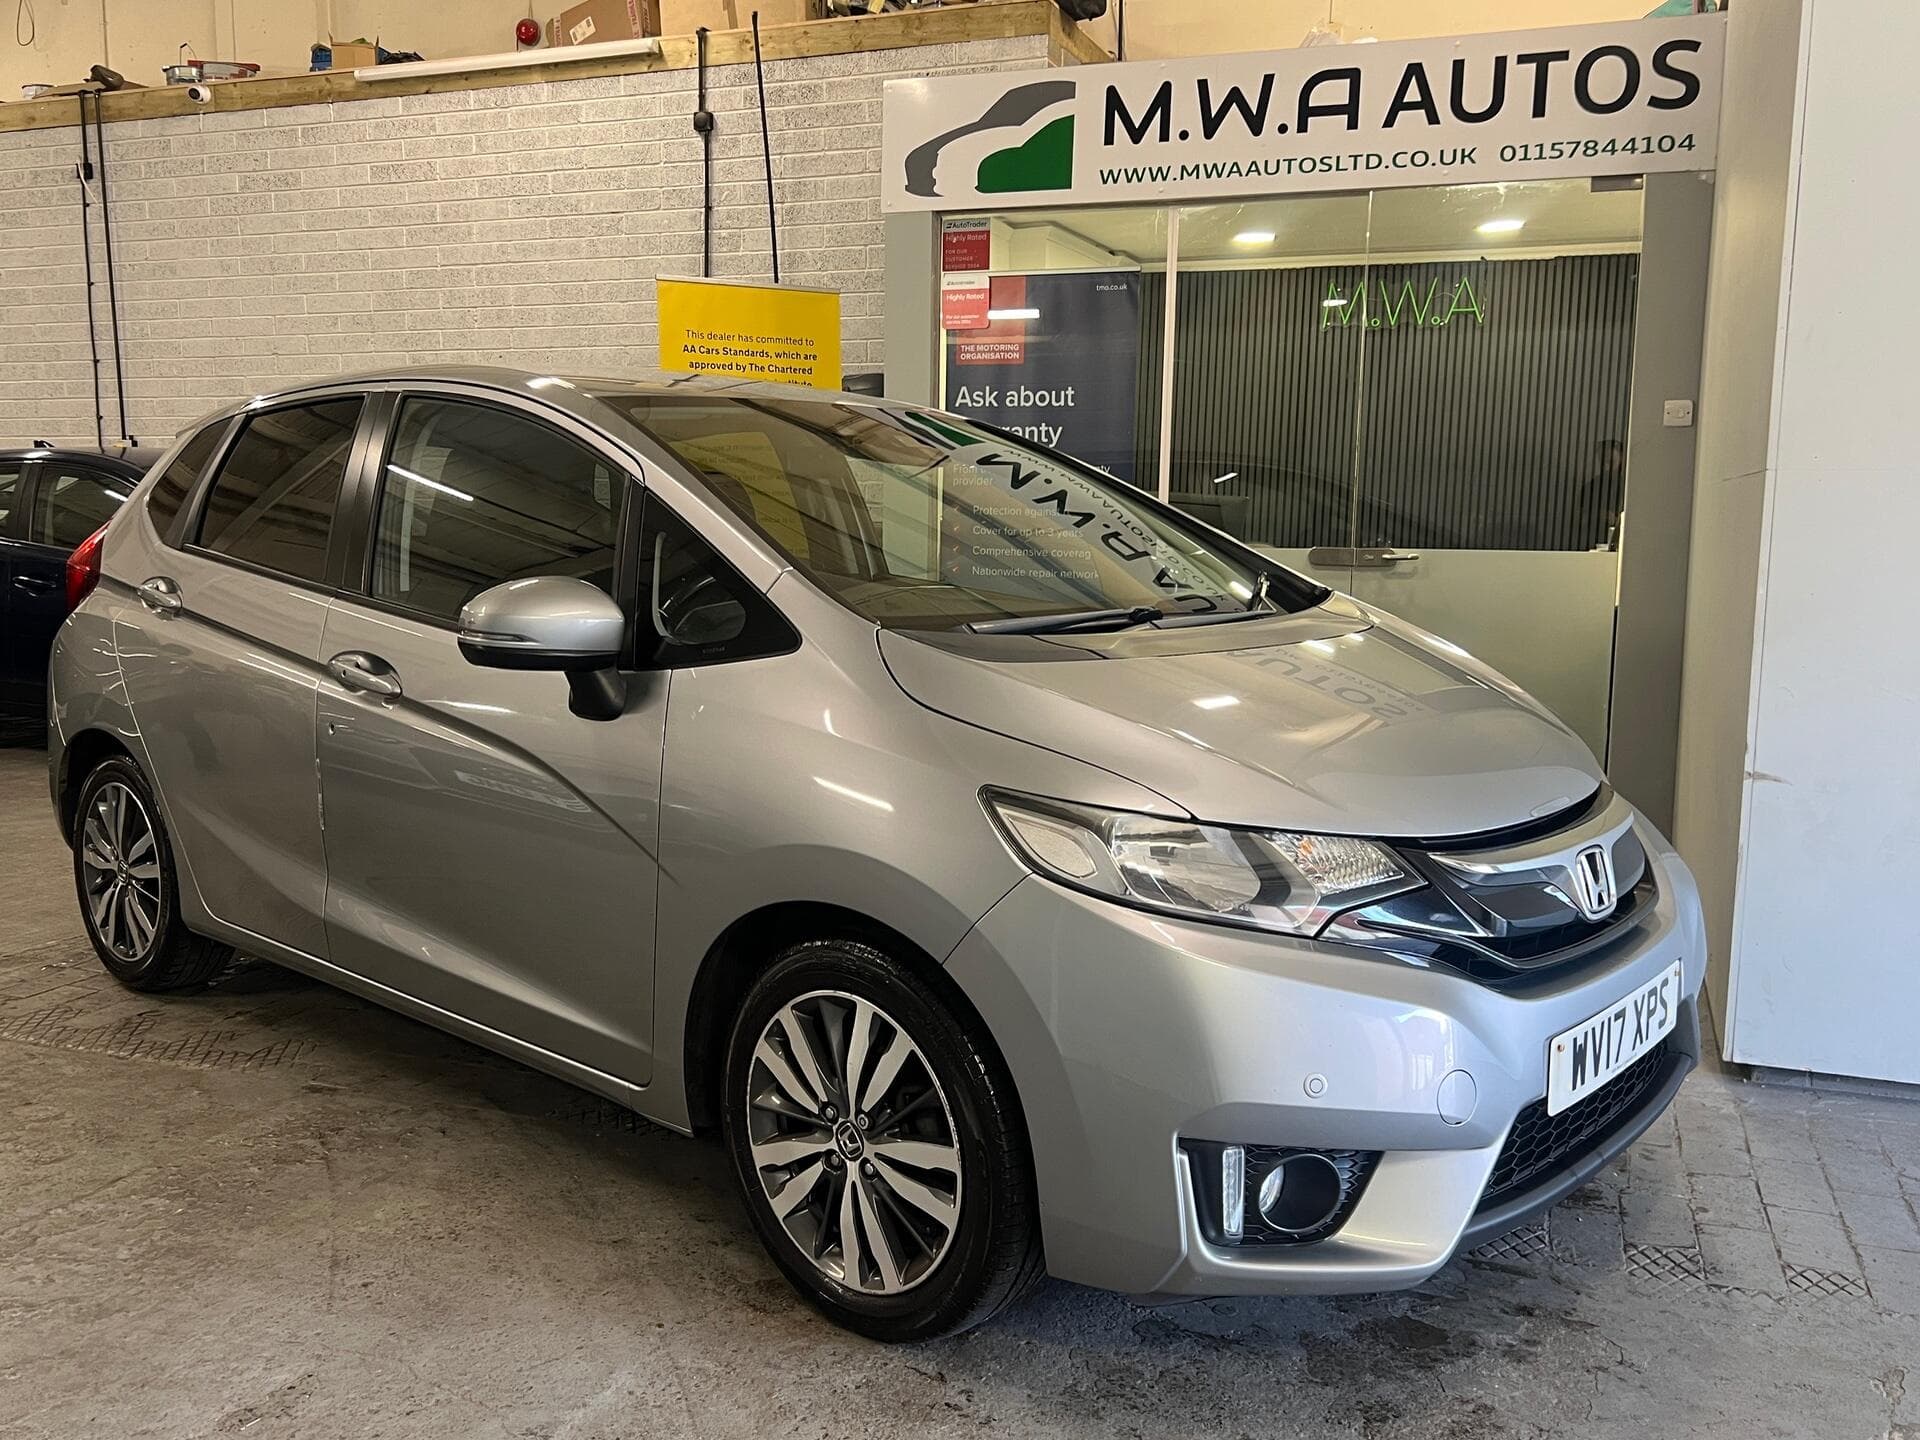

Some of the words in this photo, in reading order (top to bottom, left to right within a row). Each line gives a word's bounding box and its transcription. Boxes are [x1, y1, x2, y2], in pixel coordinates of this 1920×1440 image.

[1103, 66, 1360, 147] M.W.A
[1381, 38, 1701, 129] AUTOS
[1100, 144, 1477, 186] WWW.MWAAUTOSLTD.CO.UK
[1499, 132, 1696, 164] 01157844104
[952, 221, 987, 229] AutoTrader
[967, 233, 987, 241] Rated
[1096, 283, 1128, 291] tmo.co.uk
[946, 294, 965, 302] Highly
[966, 292, 984, 300] Rated
[1320, 276, 1484, 331] M.W.A
[685, 329, 705, 340] This
[706, 331, 736, 342] dealer
[738, 332, 754, 343] has
[756, 334, 803, 346] committed
[804, 338, 815, 346] to
[682, 344, 697, 354] AA
[698, 345, 720, 355] Cars
[722, 346, 773, 359] Standards,
[774, 349, 802, 361] which
[803, 353, 818, 361] are
[960, 344, 975, 352] THE
[976, 343, 1020, 352] MOTORING
[960, 352, 1020, 361] ORGANISATION
[688, 361, 733, 374] approved
[735, 362, 747, 373] by
[748, 363, 766, 373] The
[767, 364, 813, 375] Chartered
[955, 385, 999, 407] Ask
[1005, 385, 1076, 407] about
[952, 476, 993, 487] provider
[972, 504, 1022, 516] Protection
[972, 525, 1001, 536] Cover
[1004, 526, 1018, 537] for
[1019, 528, 1032, 538] up
[1035, 528, 1045, 537] to
[1047, 527, 1054, 537] 3
[1056, 530, 1084, 539] years
[972, 545, 1049, 558] Comprehensive
[972, 566, 1026, 577] Nationwide
[1028, 569, 1057, 579] repair
[1060, 569, 1099, 580] network
[1571, 1006, 1627, 1091] WV17
[1632, 976, 1669, 1052] XPS
